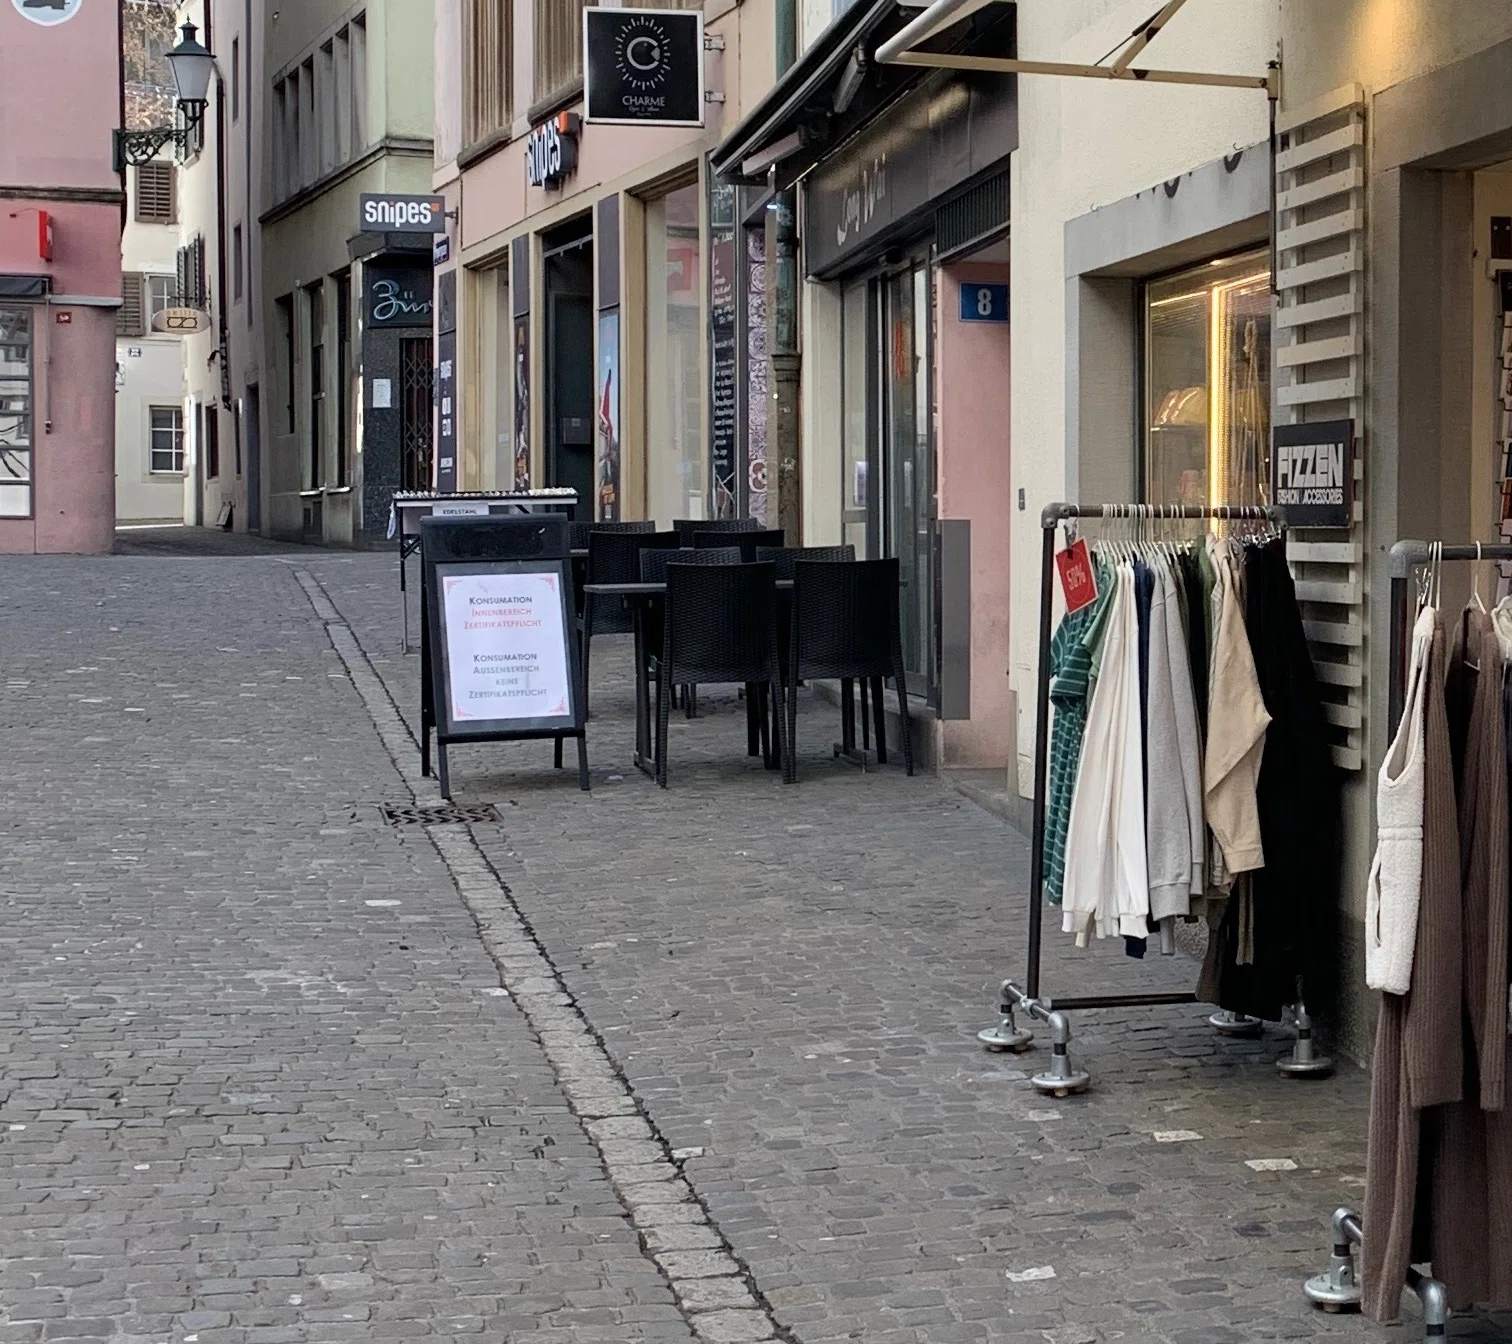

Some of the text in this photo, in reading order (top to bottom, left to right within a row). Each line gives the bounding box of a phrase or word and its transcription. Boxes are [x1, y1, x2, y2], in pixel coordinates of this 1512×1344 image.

[622, 95, 666, 107] CHARME
[365, 201, 432, 228] snipes
[977, 288, 992, 316] 8
[1277, 443, 1344, 488] FIZZEN
